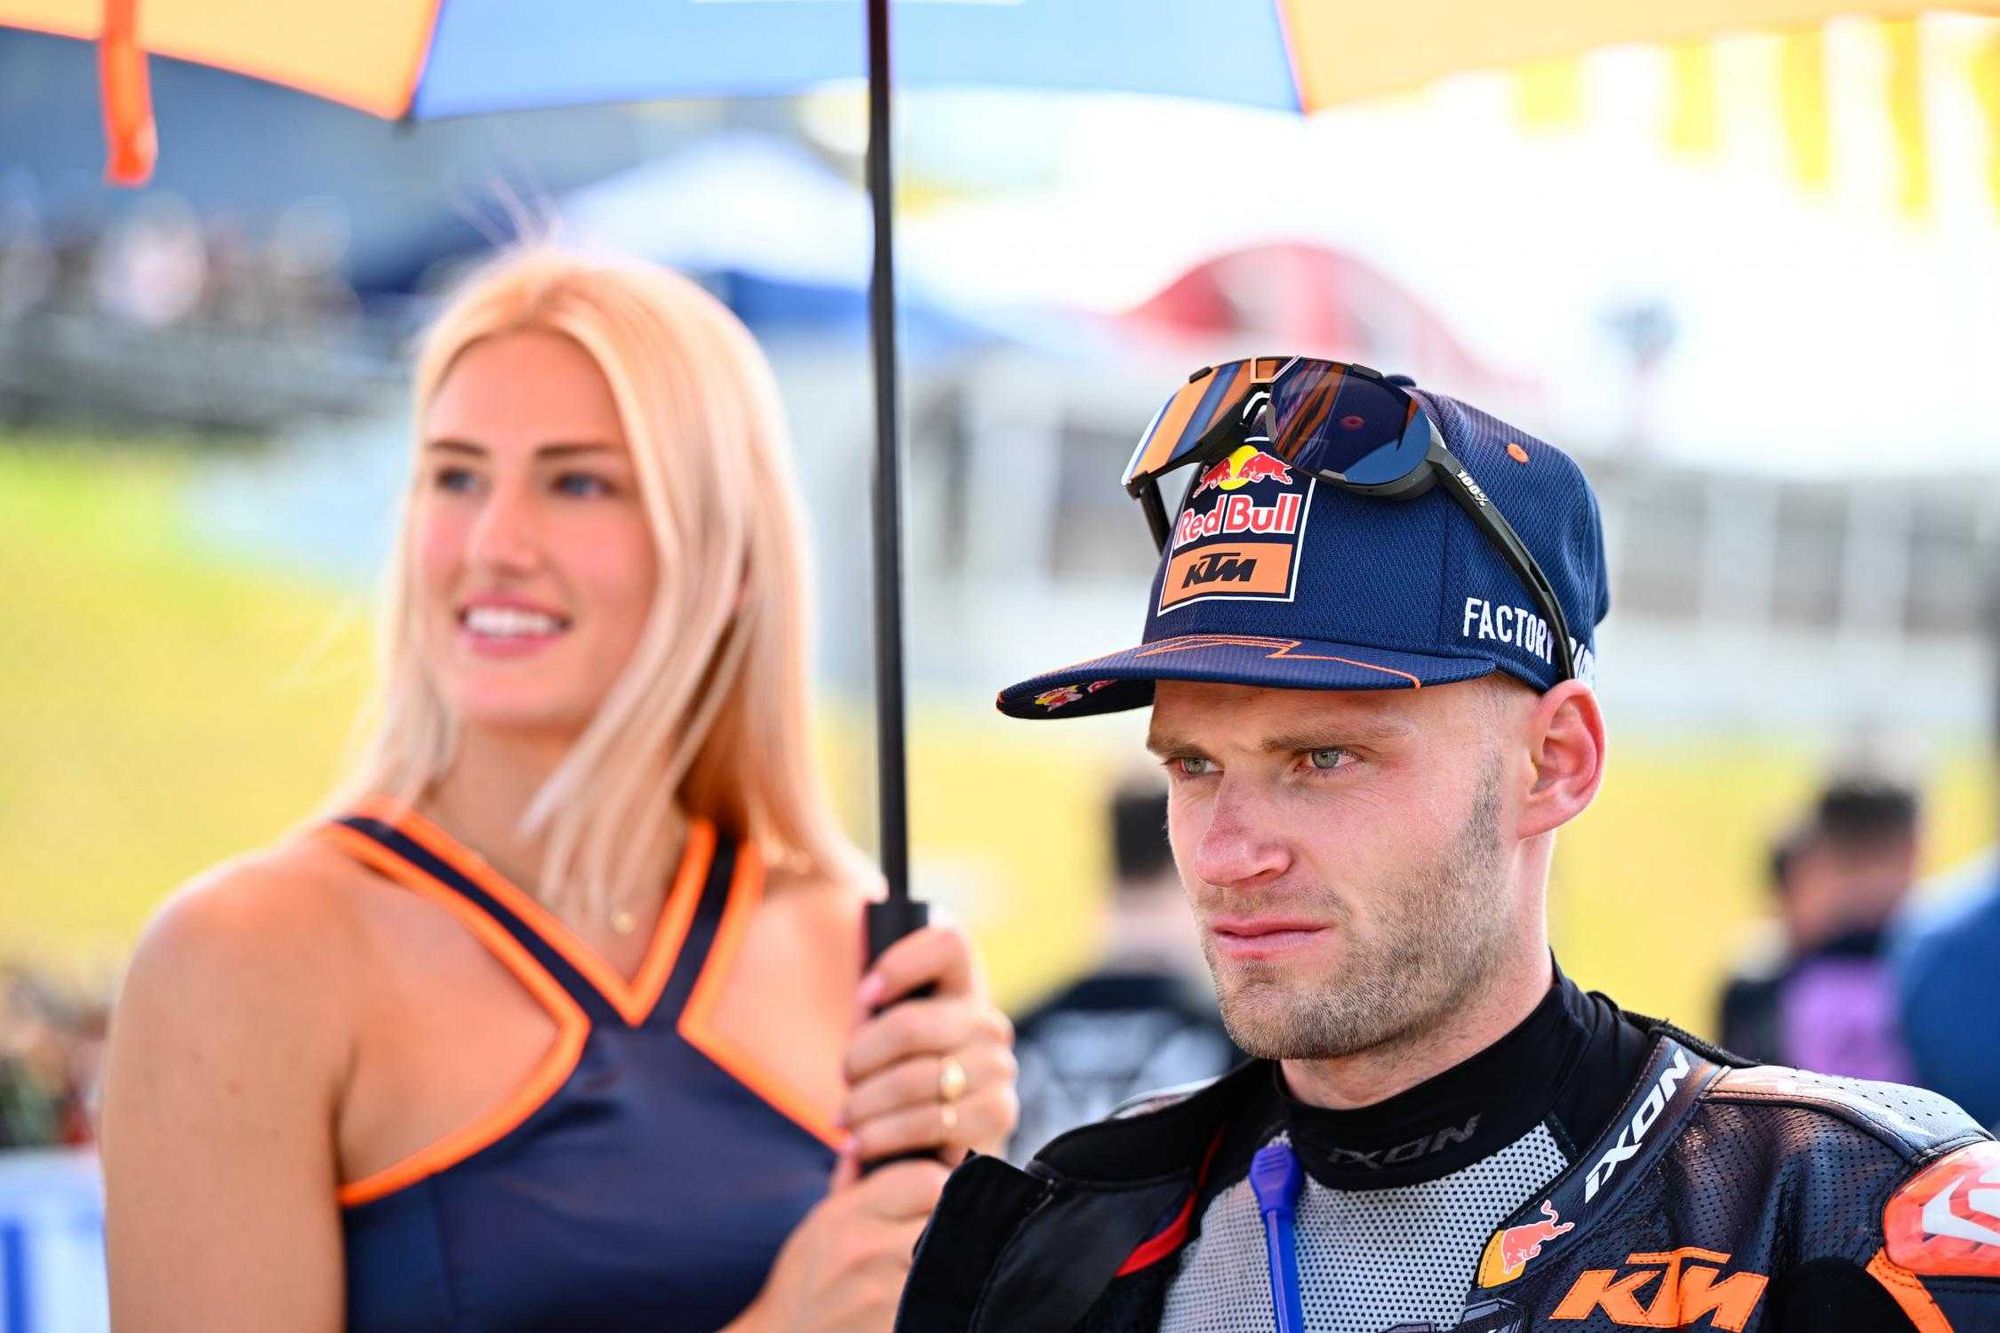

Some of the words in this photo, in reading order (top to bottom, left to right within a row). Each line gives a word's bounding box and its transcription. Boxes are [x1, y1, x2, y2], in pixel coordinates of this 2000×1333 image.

[1456, 469, 1489, 507] 100%
[1174, 494, 1227, 550] Red
[1223, 493, 1302, 534] Bull
[1181, 552, 1257, 589] KTM
[1327, 1113, 1481, 1169] IXON
[1585, 1048, 1691, 1203] IXON
[1549, 1247, 1769, 1332] KTM
